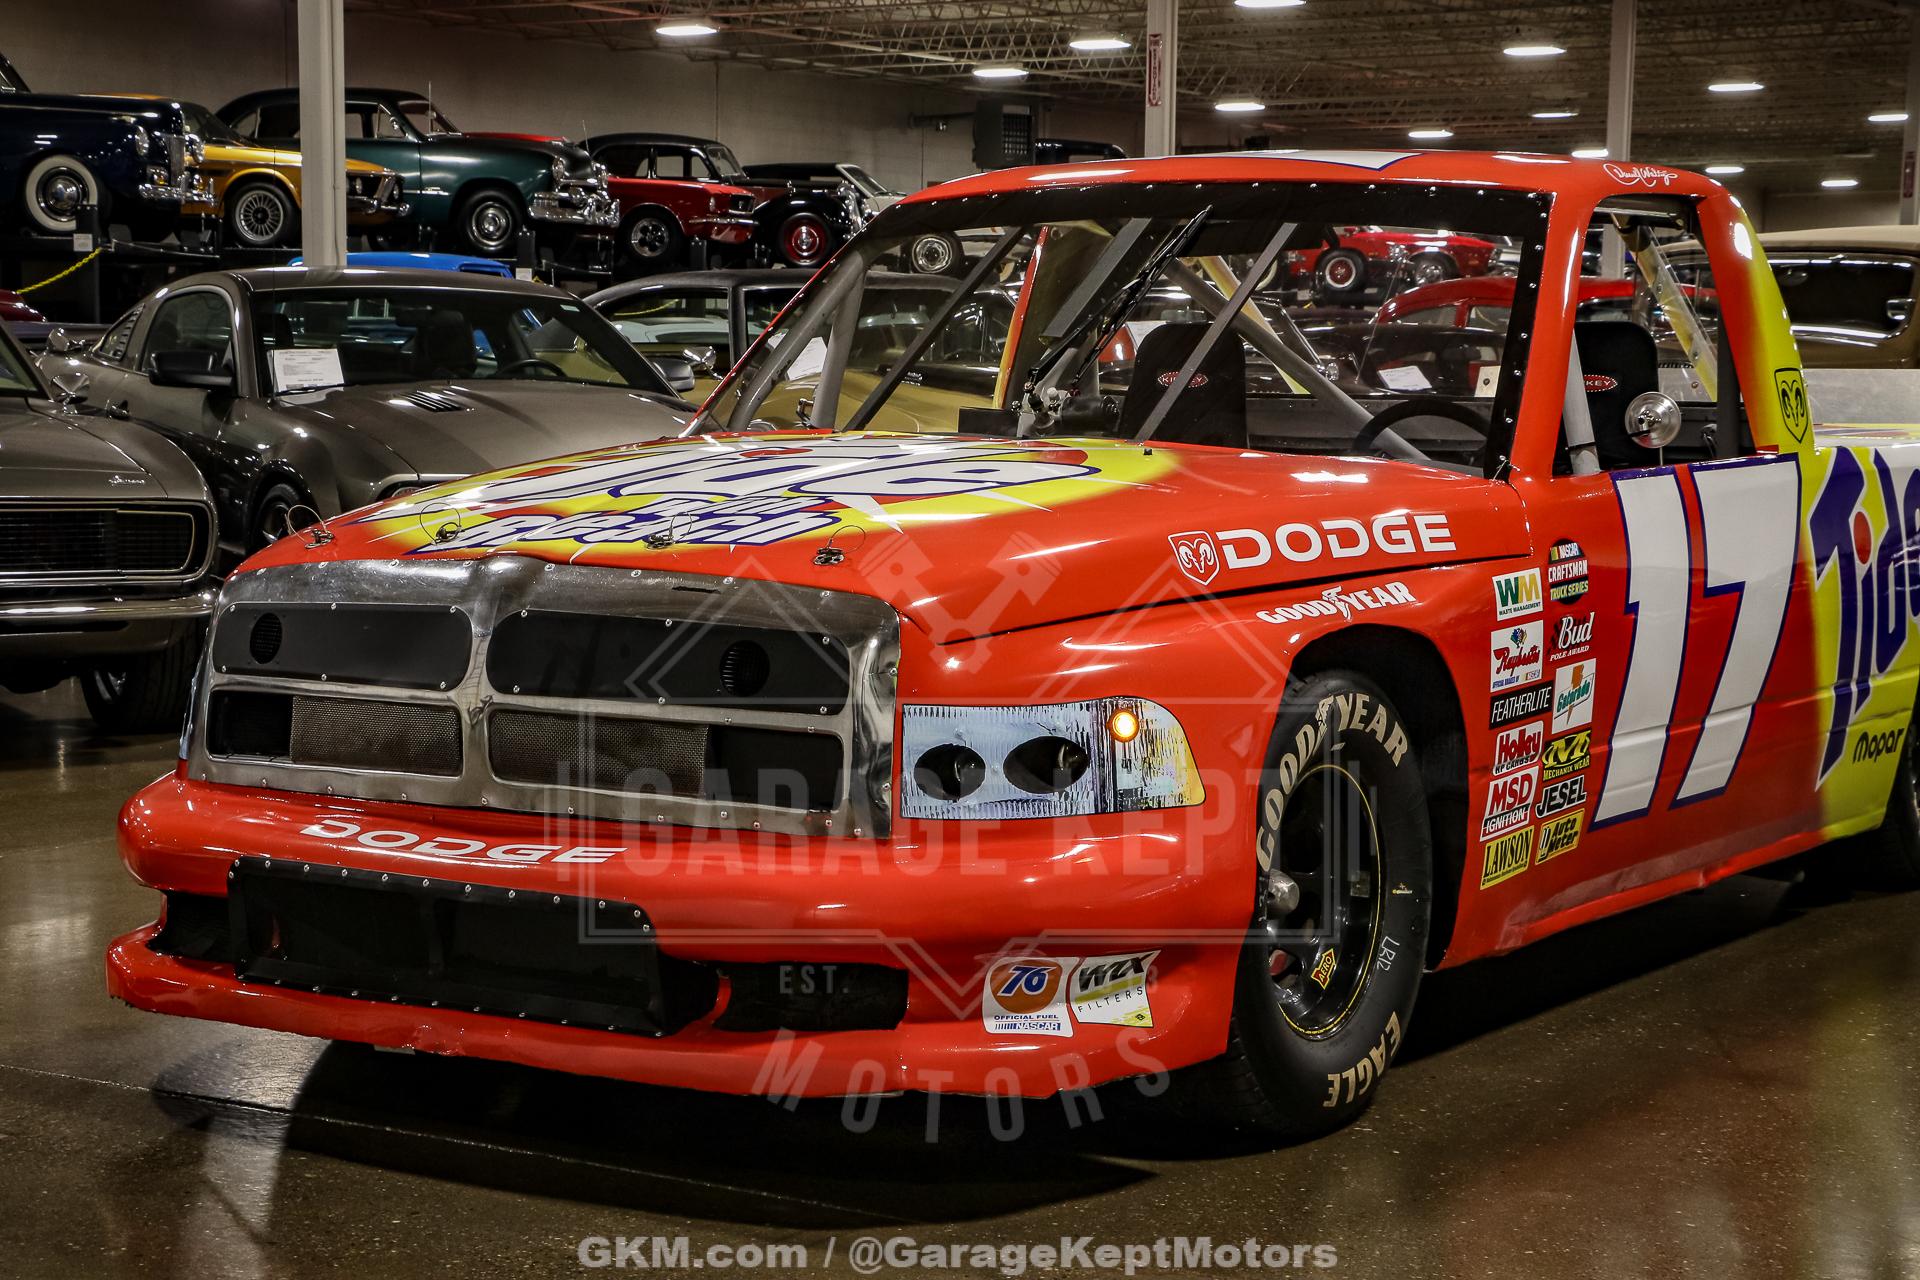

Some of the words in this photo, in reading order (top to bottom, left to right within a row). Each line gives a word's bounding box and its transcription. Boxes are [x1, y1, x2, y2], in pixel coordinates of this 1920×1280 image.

[1215, 514, 1457, 570] DODGE
[1559, 542, 1580, 559] NASCAR
[1548, 560, 1588, 583] CRAFTSMAN
[1255, 581, 1417, 624] GOODYEAR
[1496, 573, 1540, 607] WM
[1550, 584, 1568, 601] TRUCK
[1567, 580, 1589, 596] SERIES
[1499, 607, 1513, 616] WASTE
[1513, 601, 1541, 613] MANAGEMENT
[1558, 611, 1595, 649] Bud
[1588, 453, 1800, 834] 17
[1550, 650, 1568, 662] POLE
[1568, 645, 1590, 657] AWARD
[1491, 686, 1553, 724] FEATHERLITE
[1556, 680, 1591, 713] Gatorade
[1499, 728, 1542, 765] Holley
[1852, 727, 1905, 764] Mopar
[1505, 756, 1530, 770] CARBS
[1543, 765, 1574, 781] MECHANIX
[1574, 755, 1590, 771] WEAR
[1256, 693, 1408, 873] GOODYEAR
[1488, 773, 1533, 816] MSD
[1536, 776, 1587, 817] JESEL
[1486, 808, 1526, 834] IGNITION
[1553, 817, 1578, 837] Auto
[299, 819, 628, 864] DODGE
[1484, 829, 1533, 878] LAWSON
[1547, 831, 1579, 853] Meter
[997, 965, 1057, 996] 76
[1078, 951, 1156, 993] WIX
[1318, 956, 1332, 983] AERO
[1077, 986, 1143, 1013] FILTERS
[1015, 1022, 1061, 1031] NASCAR
[1323, 1010, 1403, 1108] EAGLE
